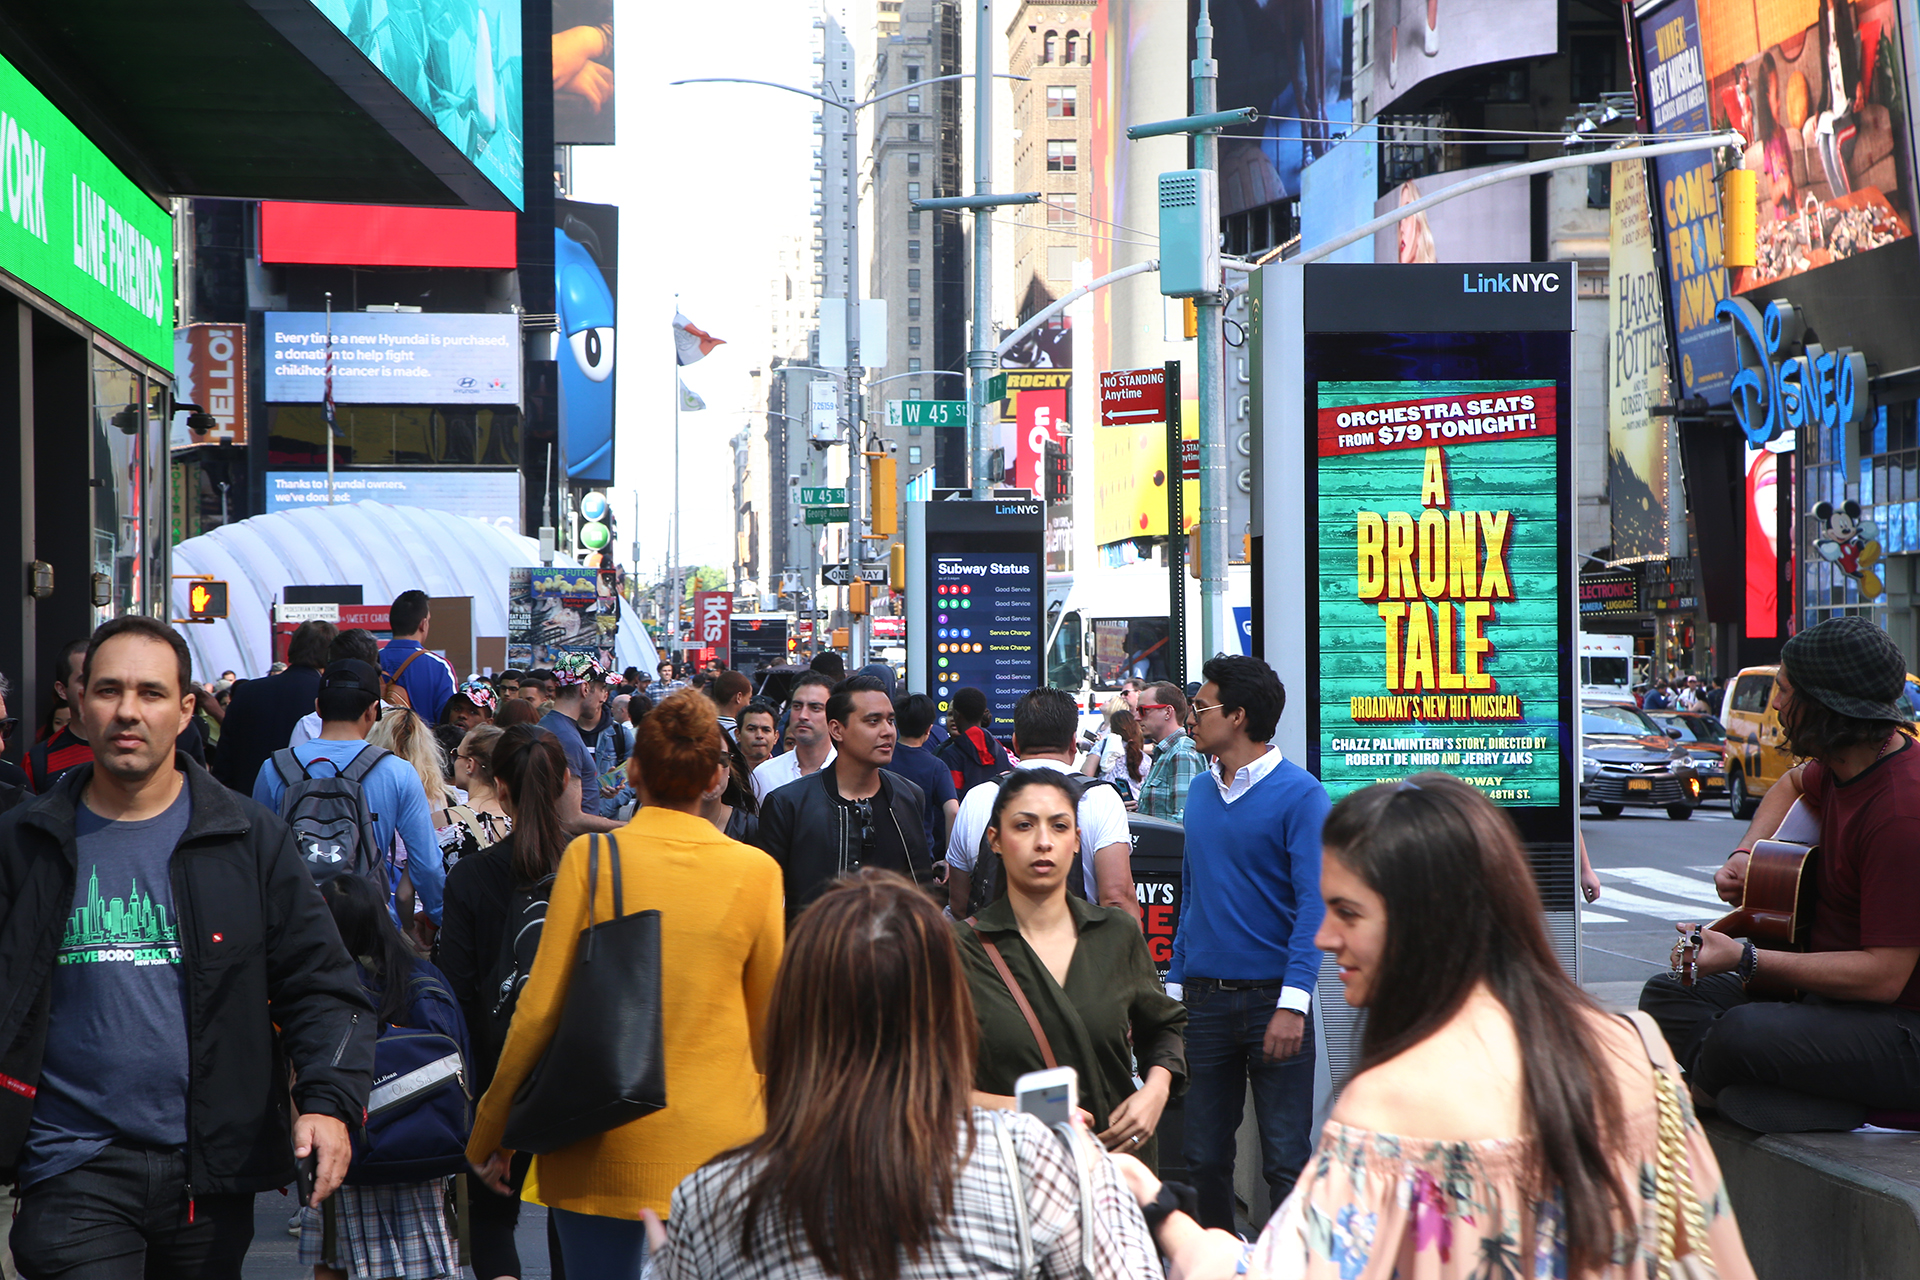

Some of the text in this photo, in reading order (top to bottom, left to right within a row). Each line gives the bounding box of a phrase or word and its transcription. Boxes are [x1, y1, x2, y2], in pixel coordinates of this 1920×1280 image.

[1650, 46, 1702, 108] BEST MUSICAL
[0, 111, 48, 244] ORK
[1665, 162, 1717, 228] COME
[72, 173, 163, 327] LINE FRIENDS
[1463, 273, 1560, 293] LinkNYC
[1679, 267, 1725, 333] AWAY
[275, 332, 309, 345] Every
[340, 335, 348, 344] a
[349, 335, 377, 344] new
[378, 333, 429, 346] Hyundai
[431, 334, 441, 345] is
[442, 334, 510, 348] purchased,
[275, 350, 283, 359] a
[341, 350, 355, 360] to
[356, 350, 384, 362] help
[385, 349, 415, 363] fight
[338, 366, 380, 376] cancer
[381, 365, 393, 377] is
[393, 366, 431, 377] made.
[208, 329, 235, 438] HELLO!
[1006, 374, 1071, 388] ROCKY
[1103, 373, 1164, 388] NO STANDING
[1104, 388, 1142, 401] Anytime
[905, 404, 921, 422] W
[929, 404, 948, 423] 45
[1336, 395, 1535, 428] ORCHESTRA SEATS
[1338, 413, 1536, 447] FROM $79 TONIGHT!
[1421, 446, 1446, 506] A
[275, 479, 311, 489] Thanks
[312, 480, 323, 489] to
[366, 481, 406, 490] owners,
[275, 493, 304, 502] we've
[803, 490, 814, 502] W
[818, 490, 832, 502] 45
[807, 509, 827, 519] George
[995, 505, 1039, 515] LinkNYC
[1357, 509, 1513, 600] BRONX
[532, 569, 559, 577] VEGAN
[566, 569, 597, 577] FUTURE
[831, 570, 849, 580] ONE
[938, 563, 1030, 577] Subway Status
[1605, 600, 1635, 610] LUGGAGE
[347, 614, 369, 623] SWEET
[703, 595, 728, 642] tkts
[1378, 601, 1492, 690] TALE
[1350, 695, 1519, 719] BROADWAY'S NEW HIT MUSICAL
[1332, 737, 1547, 751] CHAZZ PALMINTERI'S STORY, DIRECTED BY
[1345, 752, 1533, 766] ROBERT DE NIRO AND JERRY ZAKS
[1457, 777, 1503, 786] ADWAY
[1489, 790, 1531, 799] 48TH ST.
[1133, 883, 1174, 904] AY'S
